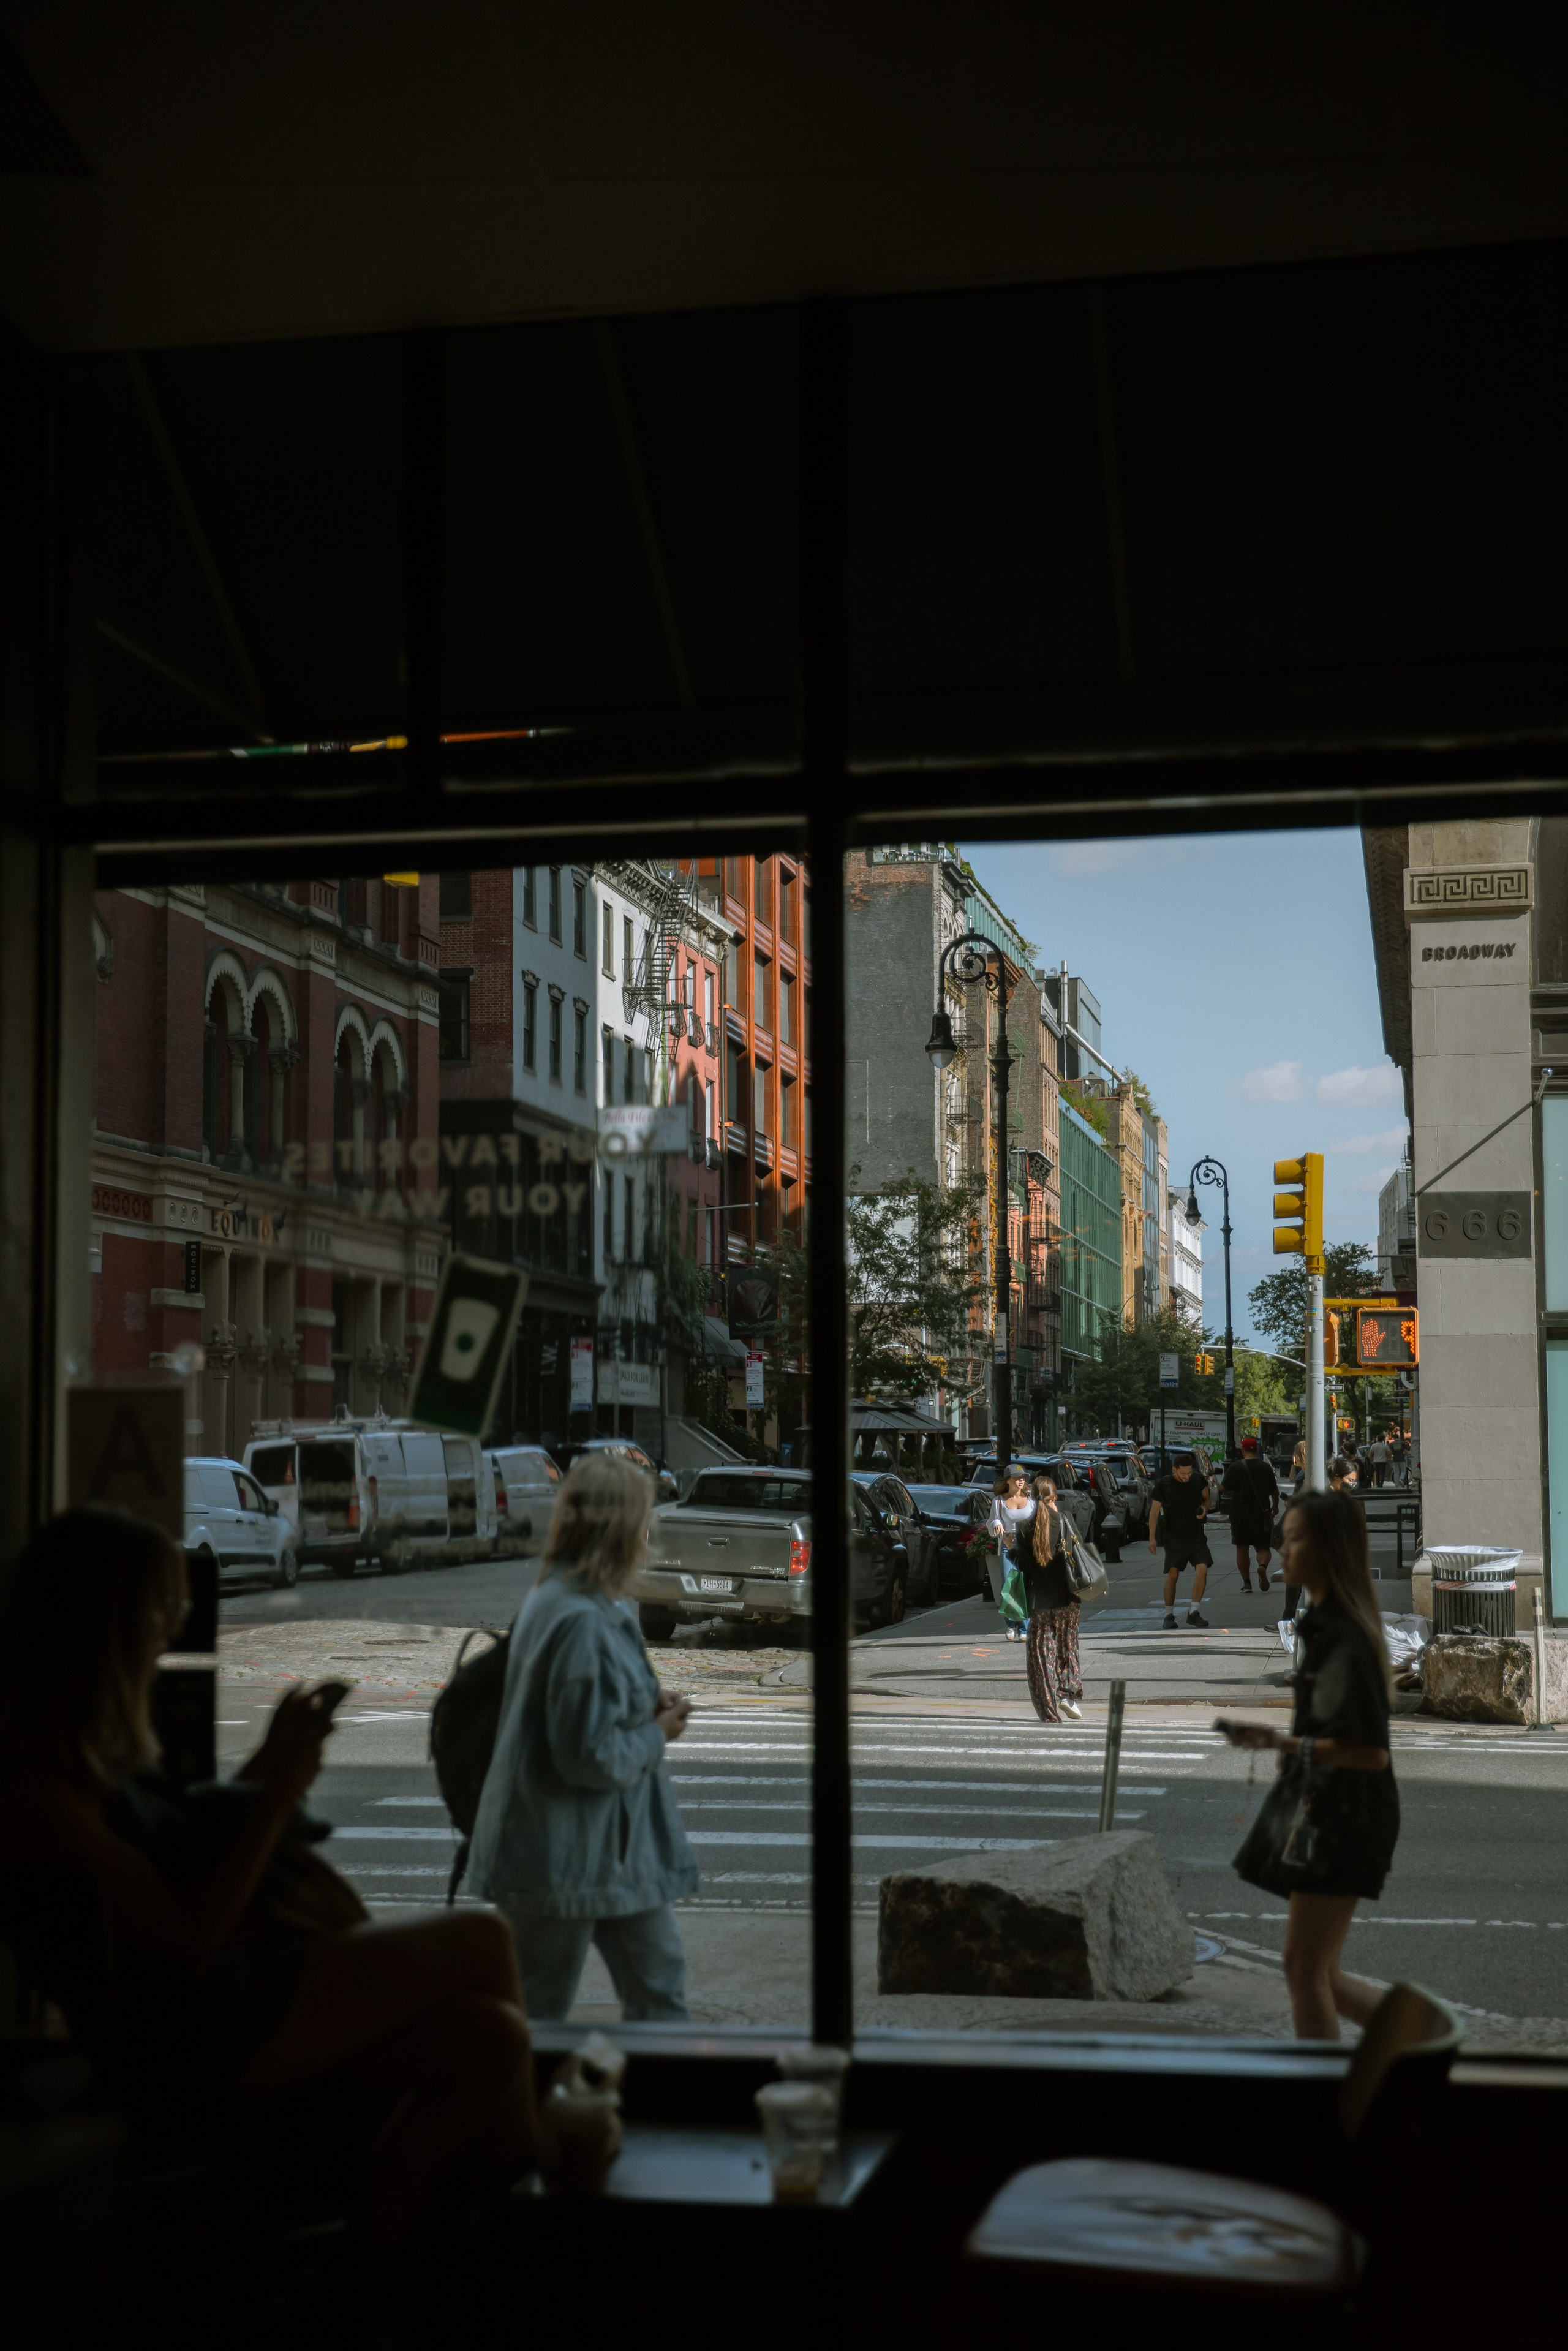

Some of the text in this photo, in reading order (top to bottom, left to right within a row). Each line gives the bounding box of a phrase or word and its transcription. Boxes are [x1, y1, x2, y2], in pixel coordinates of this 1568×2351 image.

[1422, 943, 1517, 962] BROADWAY
[211, 1210, 279, 1243] EQUINOX
[1425, 1210, 1521, 1240] 666
[1401, 1320, 1415, 1354] 9
[620, 1370, 630, 1381] SPACE
[88, 1403, 165, 1496] A
